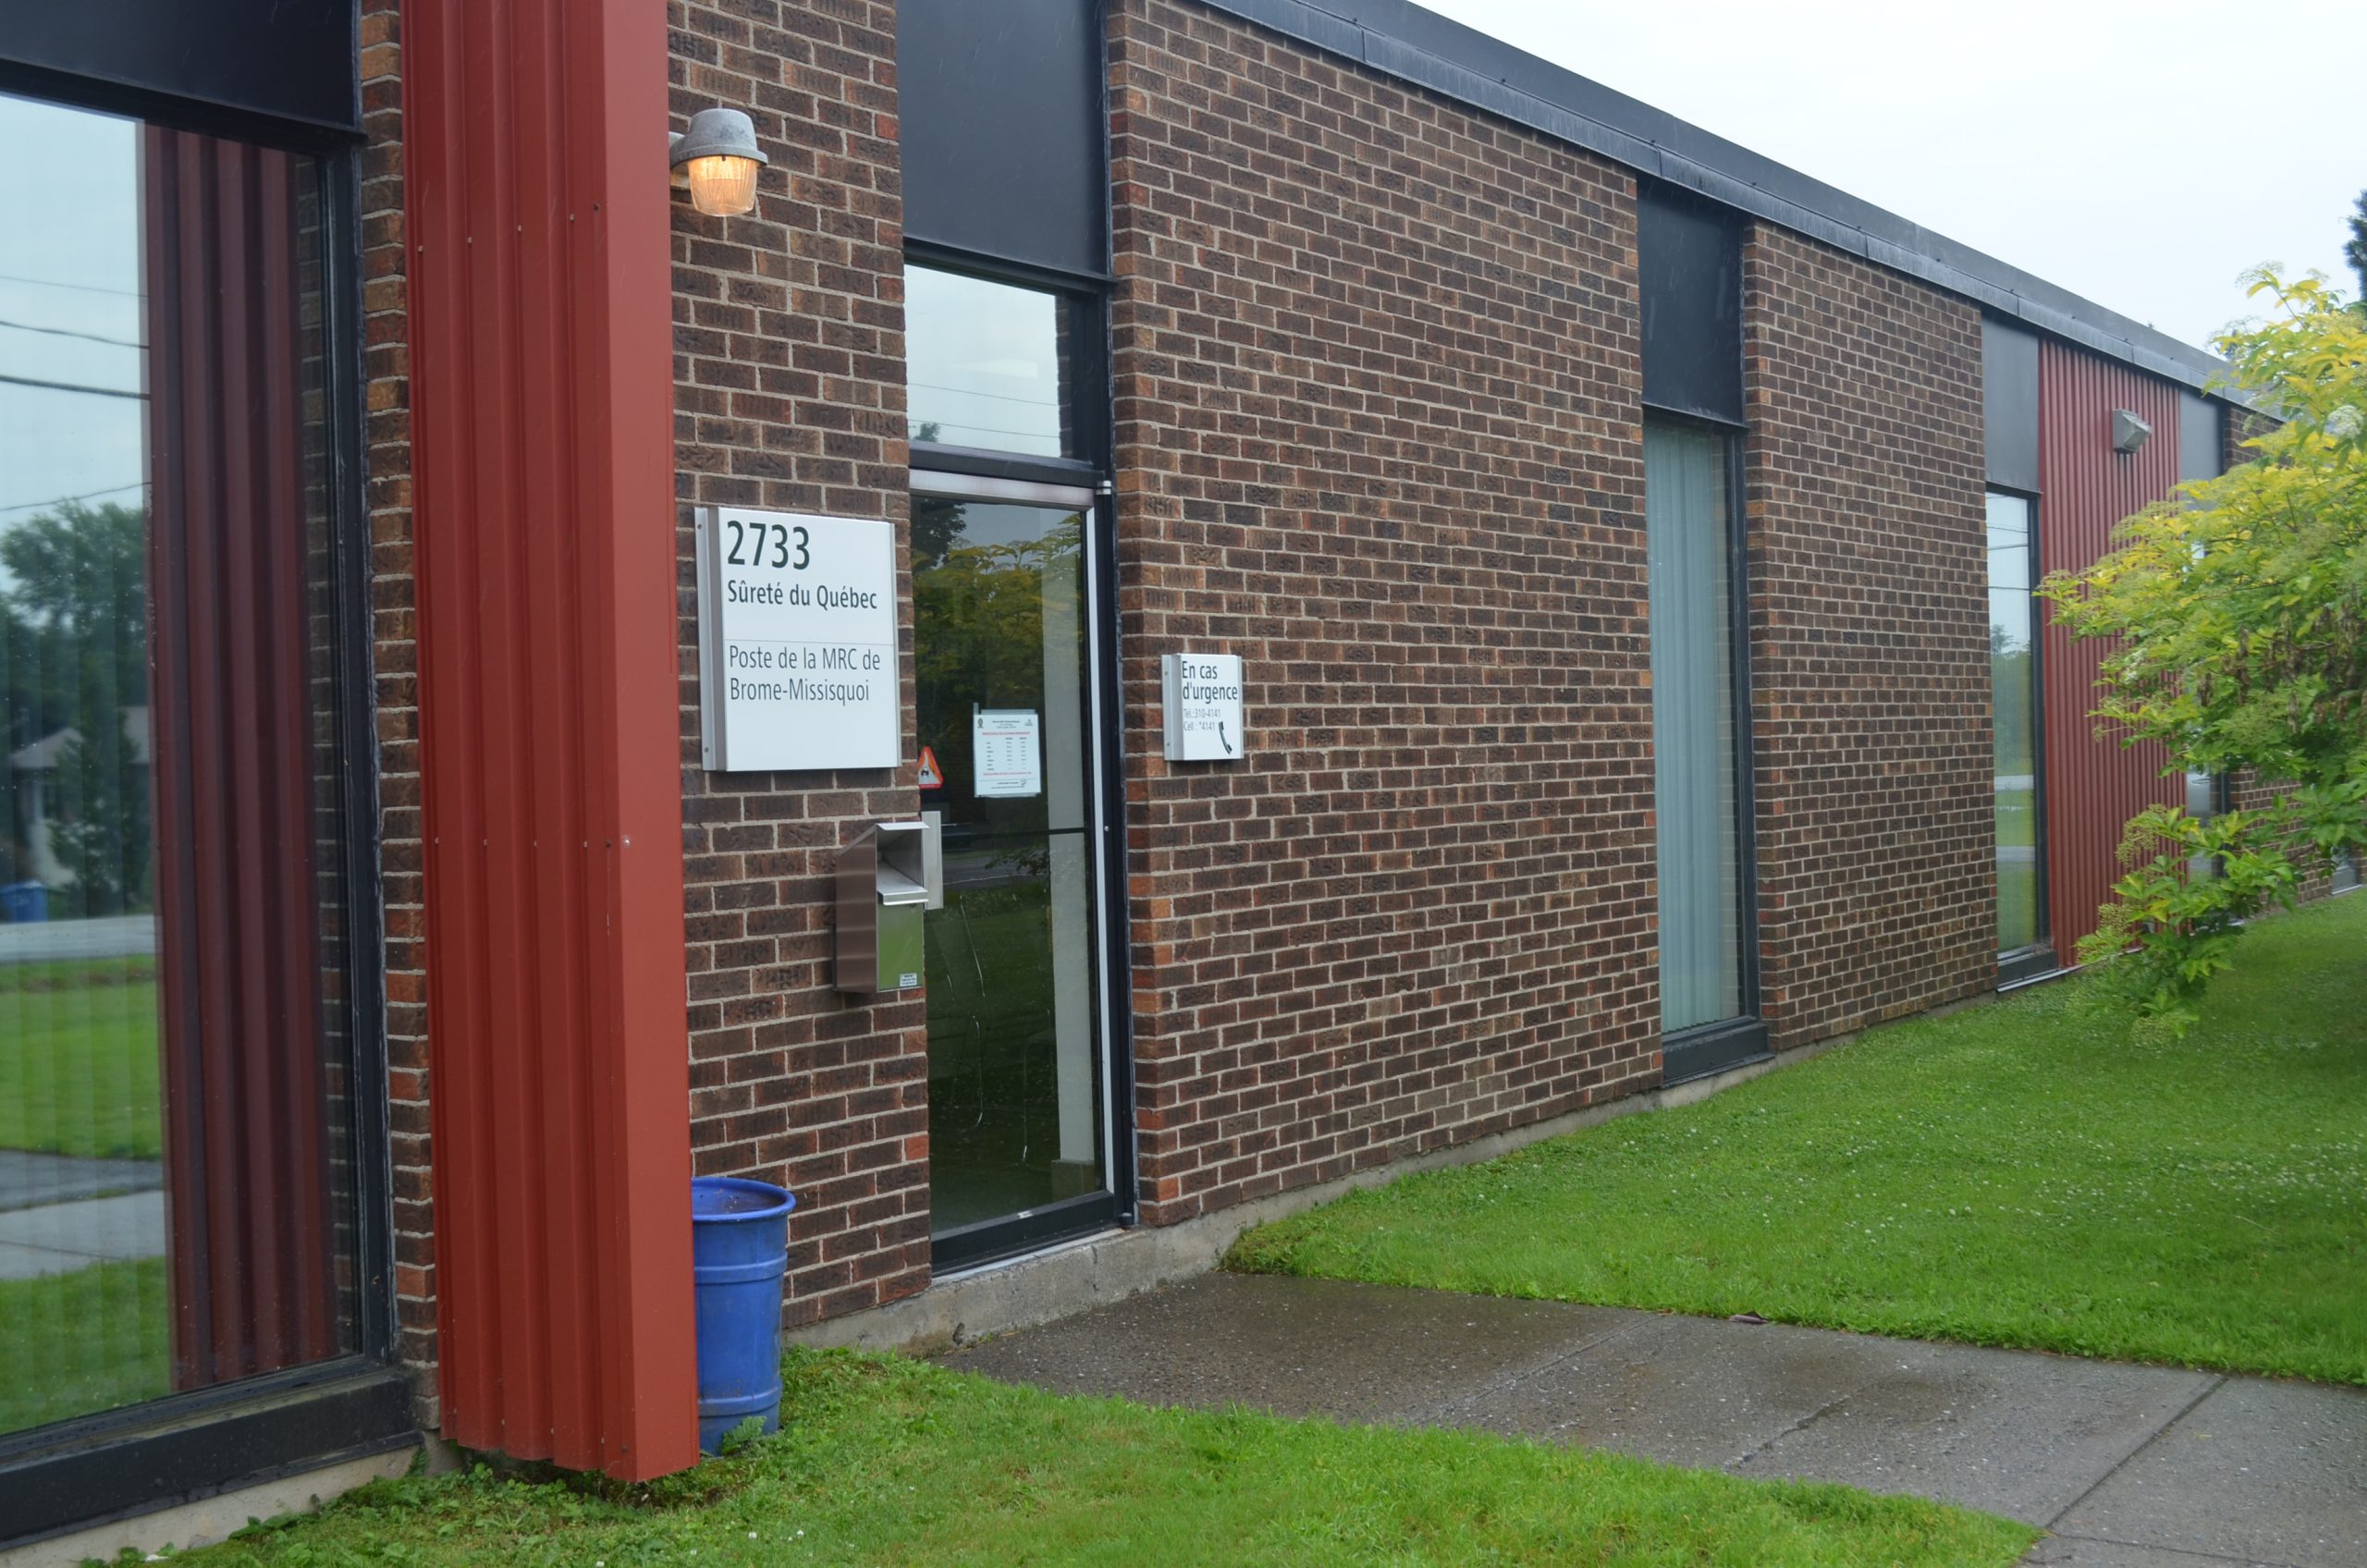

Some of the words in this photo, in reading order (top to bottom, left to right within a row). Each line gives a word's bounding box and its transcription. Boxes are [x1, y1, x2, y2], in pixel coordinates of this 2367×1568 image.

[727, 520, 811, 570] 2733
[728, 579, 784, 605] Sûreté
[790, 583, 811, 606] du
[816, 584, 878, 611] Québec
[730, 645, 773, 669] Poste
[779, 646, 798, 669] de
[803, 646, 816, 670] la
[823, 647, 858, 670] MRC
[863, 648, 881, 670] de
[1182, 660, 1196, 679] En
[1199, 665, 1218, 680] cas
[730, 677, 870, 706] Brome-Missisquoi
[1183, 681, 1238, 704] d'urgence
